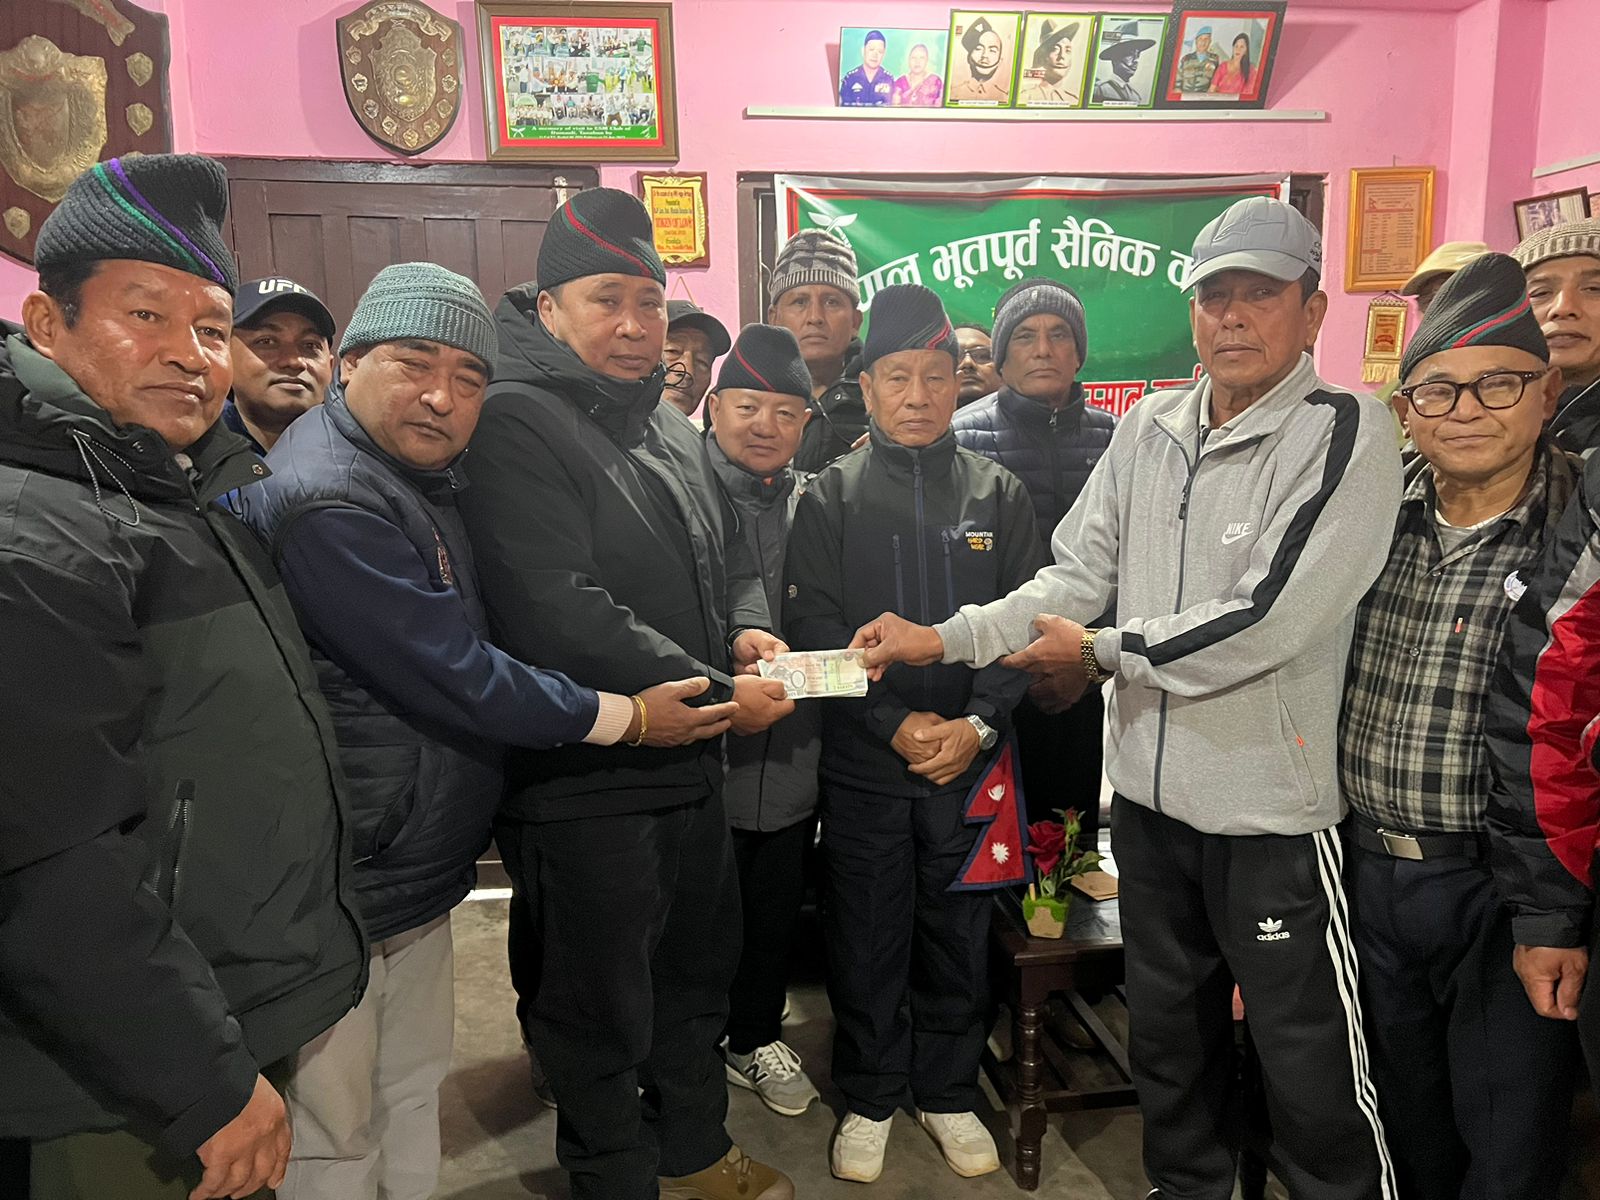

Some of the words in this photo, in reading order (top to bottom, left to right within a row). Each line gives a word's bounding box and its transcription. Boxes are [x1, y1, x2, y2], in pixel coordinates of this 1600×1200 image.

[929, 218, 1042, 289] भूतपूर्व
[1050, 215, 1161, 277] सैनिक
[1225, 522, 1251, 535] NIKE
[1256, 931, 1291, 941] adidas
